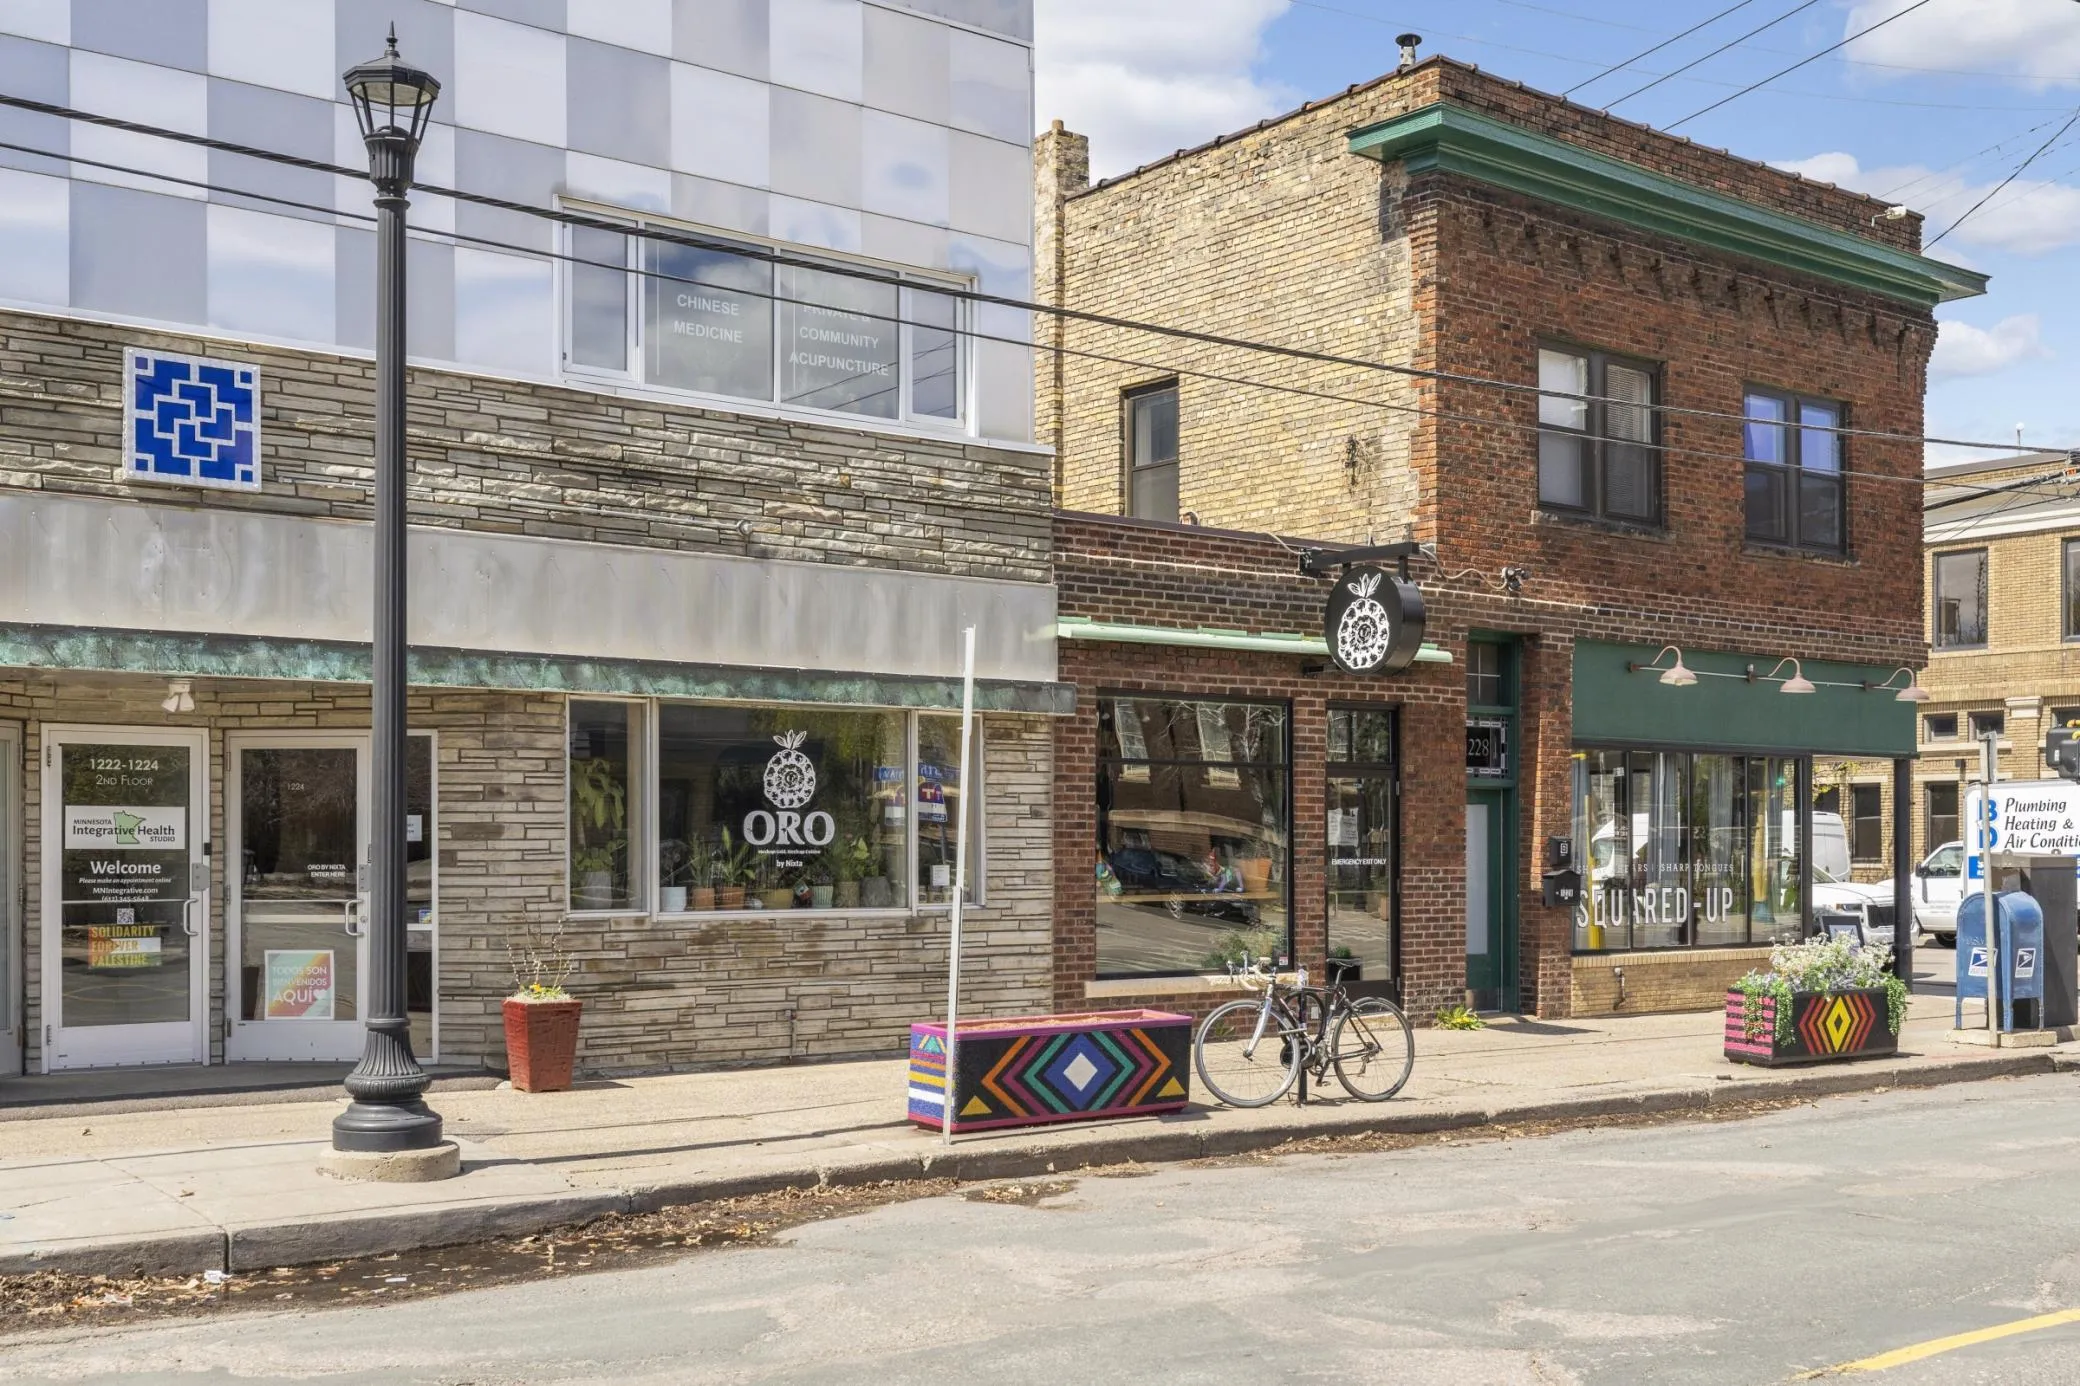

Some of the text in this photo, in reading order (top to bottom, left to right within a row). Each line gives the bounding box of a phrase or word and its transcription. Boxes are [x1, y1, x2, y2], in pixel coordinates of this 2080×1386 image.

[677, 294, 740, 316] CHINESE
[673, 320, 743, 343] MEDICINE
[799, 326, 879, 349] COMMUNITY
[789, 352, 889, 376] ACUPUNCTURE
[90, 758, 159, 771] 1222-1224
[287, 783, 305, 791] 1224
[2004, 797, 2067, 813] Plumbing
[743, 810, 835, 846] ORO
[2004, 815, 2074, 832] Heating &
[73, 825, 175, 837] Integrative Health
[2004, 833, 2027, 849] Air
[90, 860, 161, 874] Welcome
[776, 860, 785, 868] by
[1660, 863, 1690, 872] SHARP
[1693, 863, 1734, 873] TONGUES
[91, 925, 155, 938] SOLIDARITY
[91, 952, 148, 966] PALESTINE
[306, 965, 327, 975] SON
